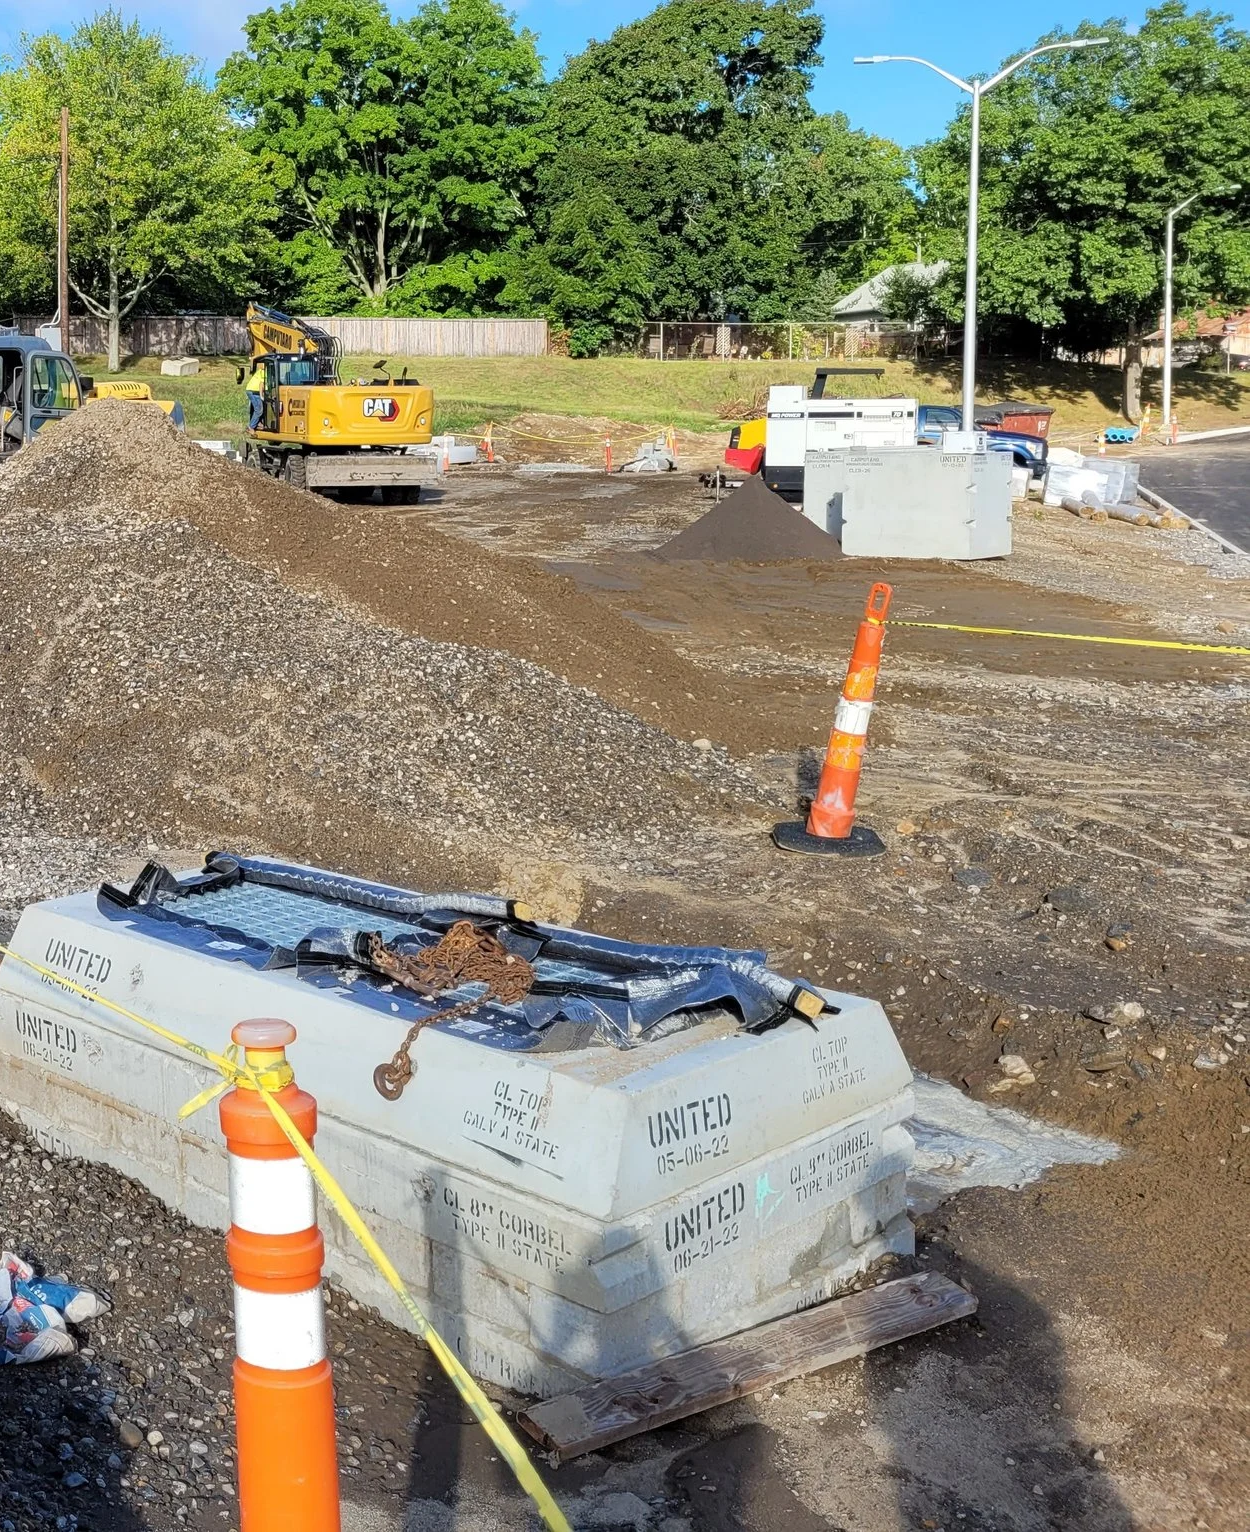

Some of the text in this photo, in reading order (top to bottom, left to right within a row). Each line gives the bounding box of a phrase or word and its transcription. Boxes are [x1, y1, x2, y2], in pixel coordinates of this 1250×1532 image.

[363, 398, 392, 417] CAT
[939, 455, 967, 463] UNITED
[45, 938, 112, 984] UNITED
[16, 1010, 77, 1053] UNITED
[812, 1035, 848, 1064] CL TOP
[22, 1040, 73, 1072] 06-21-22
[817, 1056, 848, 1080] TYPE II
[494, 1080, 512, 1101] CL
[802, 1067, 867, 1105] GALV A STATE
[463, 1110, 559, 1160] GALV A STATE
[494, 1101, 540, 1131] TYPE II
[647, 1093, 732, 1149] UNITED
[657, 1134, 730, 1175] 05-06-22
[790, 1165, 805, 1185] CL
[828, 1130, 874, 1166] CORBEL
[796, 1176, 823, 1203] TYPE
[836, 1152, 870, 1182] STATE
[443, 1187, 465, 1212] CL
[499, 1210, 572, 1256] CORBEL
[665, 1182, 745, 1252] UNITED
[452, 1212, 565, 1275] TYPE II STATE
[674, 1222, 740, 1273] 06-21-22
